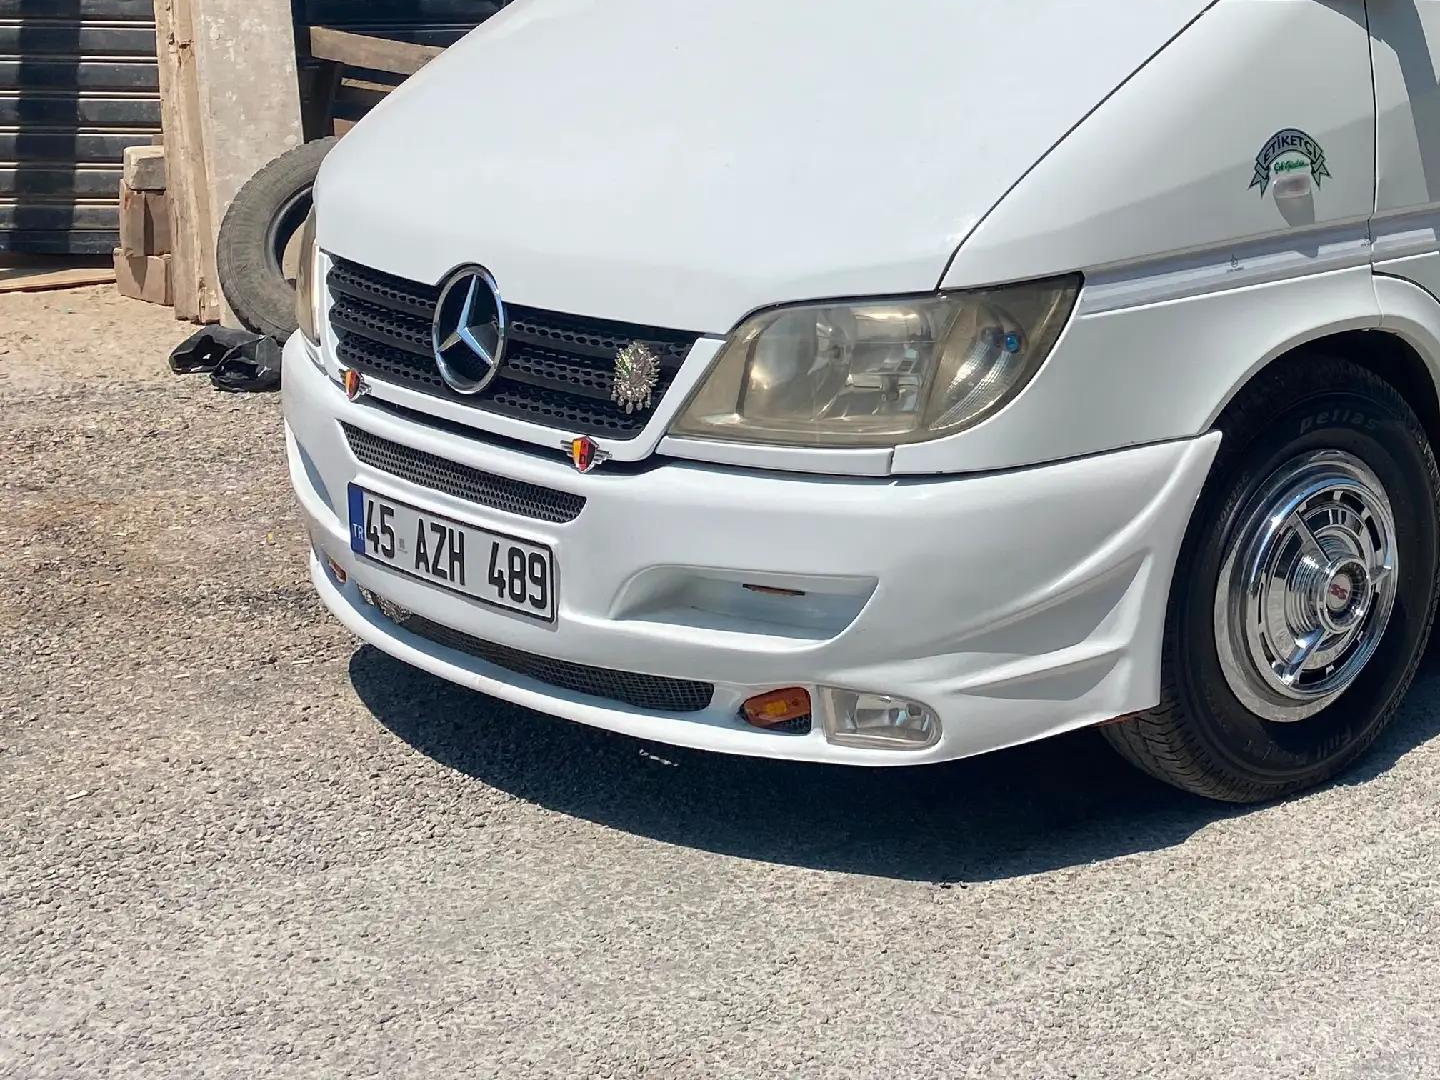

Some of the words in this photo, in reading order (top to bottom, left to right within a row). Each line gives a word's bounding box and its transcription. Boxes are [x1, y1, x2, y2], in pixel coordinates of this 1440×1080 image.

[352, 522, 364, 541] TR
[365, 499, 396, 560] 45
[414, 517, 466, 587] AZH
[487, 540, 549, 611] 489
